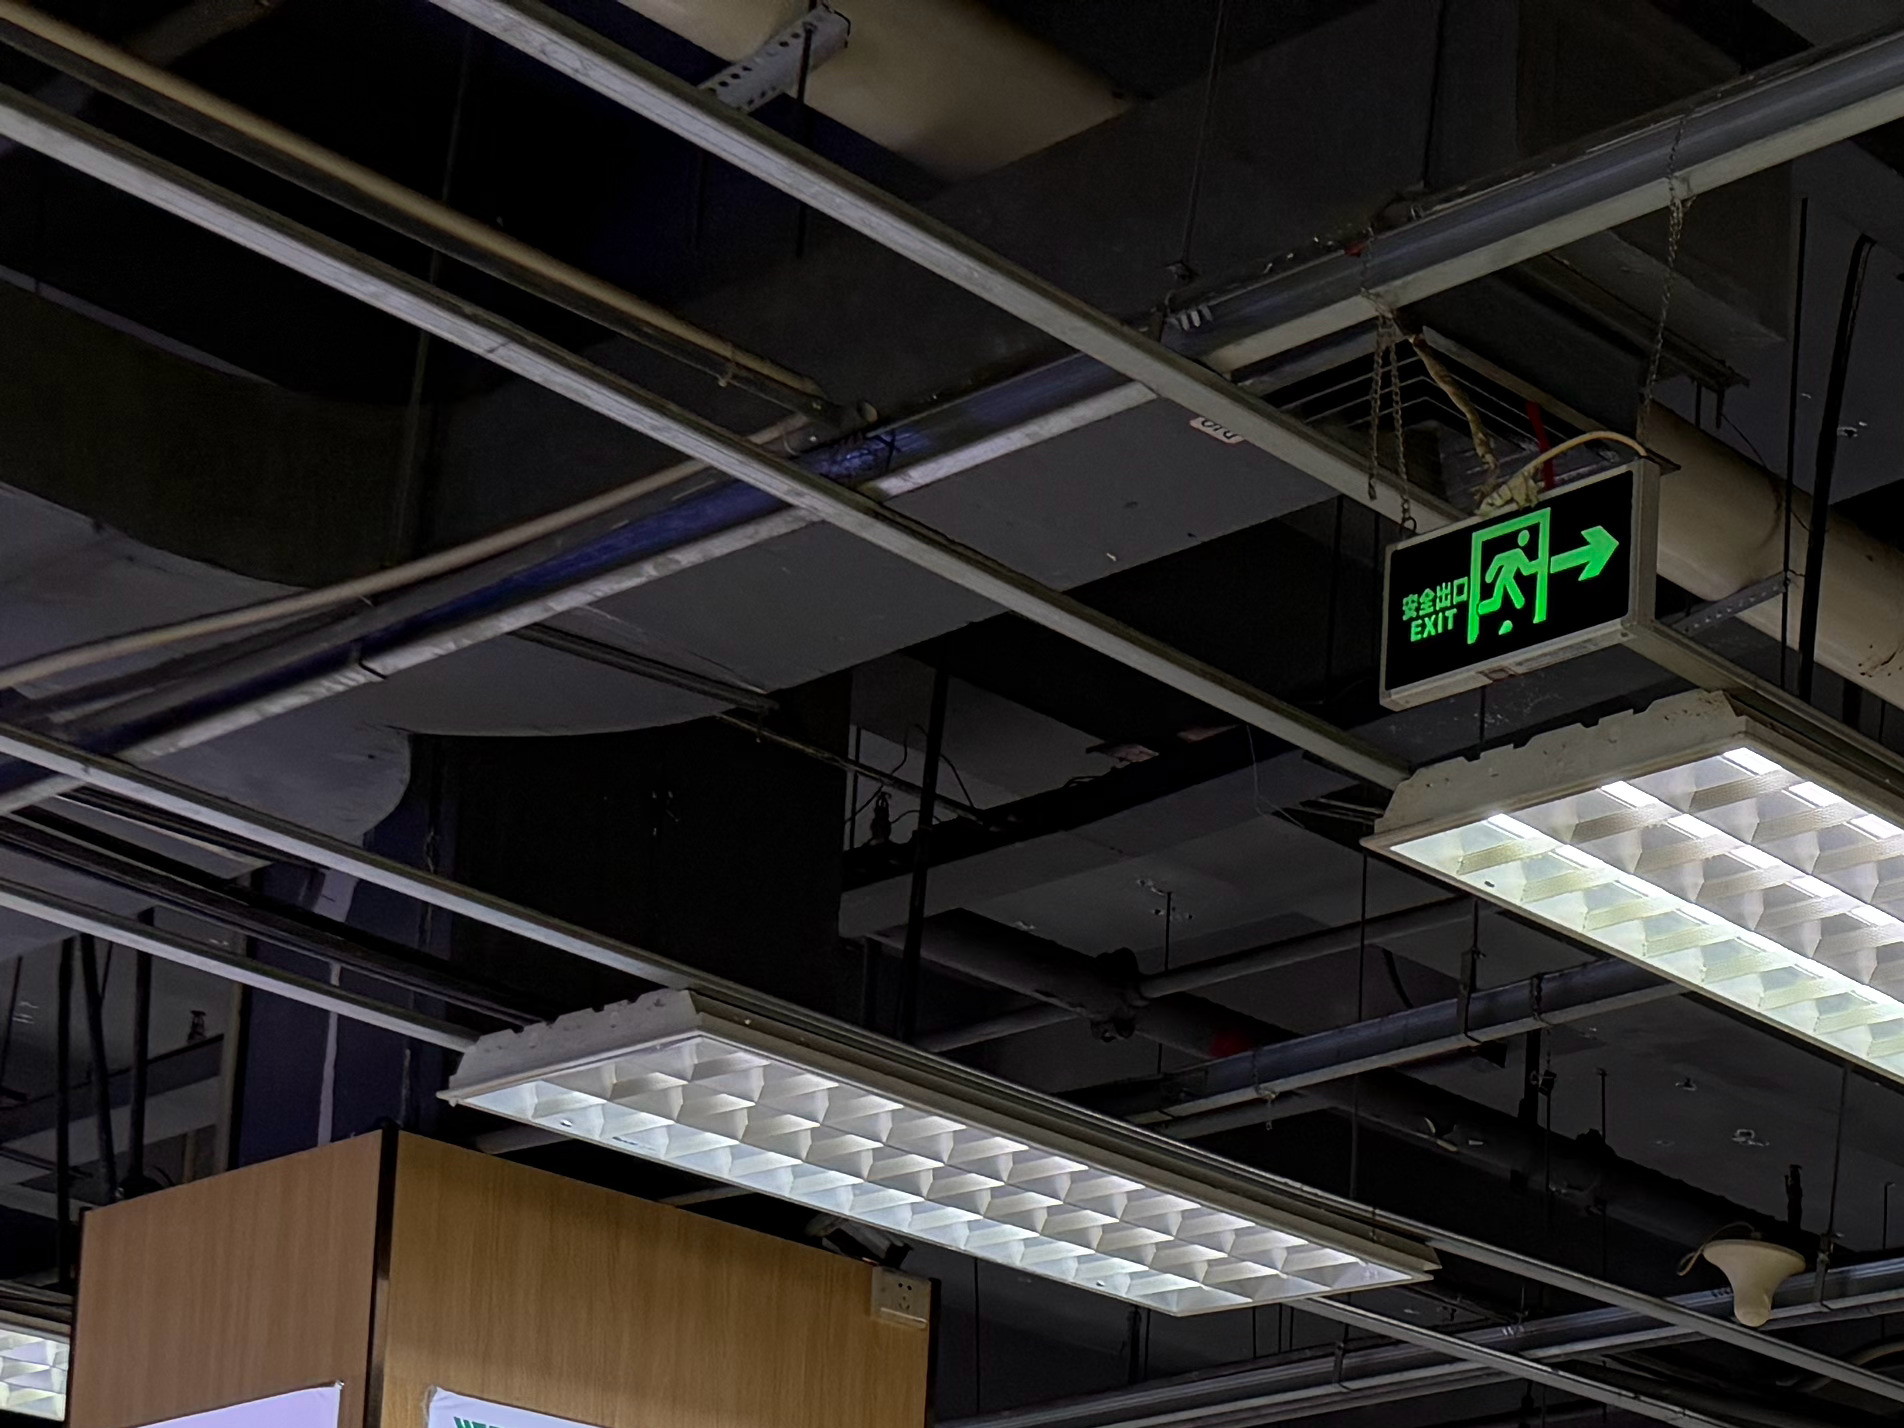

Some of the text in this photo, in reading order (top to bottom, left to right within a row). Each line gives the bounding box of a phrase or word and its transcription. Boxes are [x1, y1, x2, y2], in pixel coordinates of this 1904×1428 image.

[1402, 576, 1468, 620] 安全出口
[1410, 608, 1457, 642] EXIT
